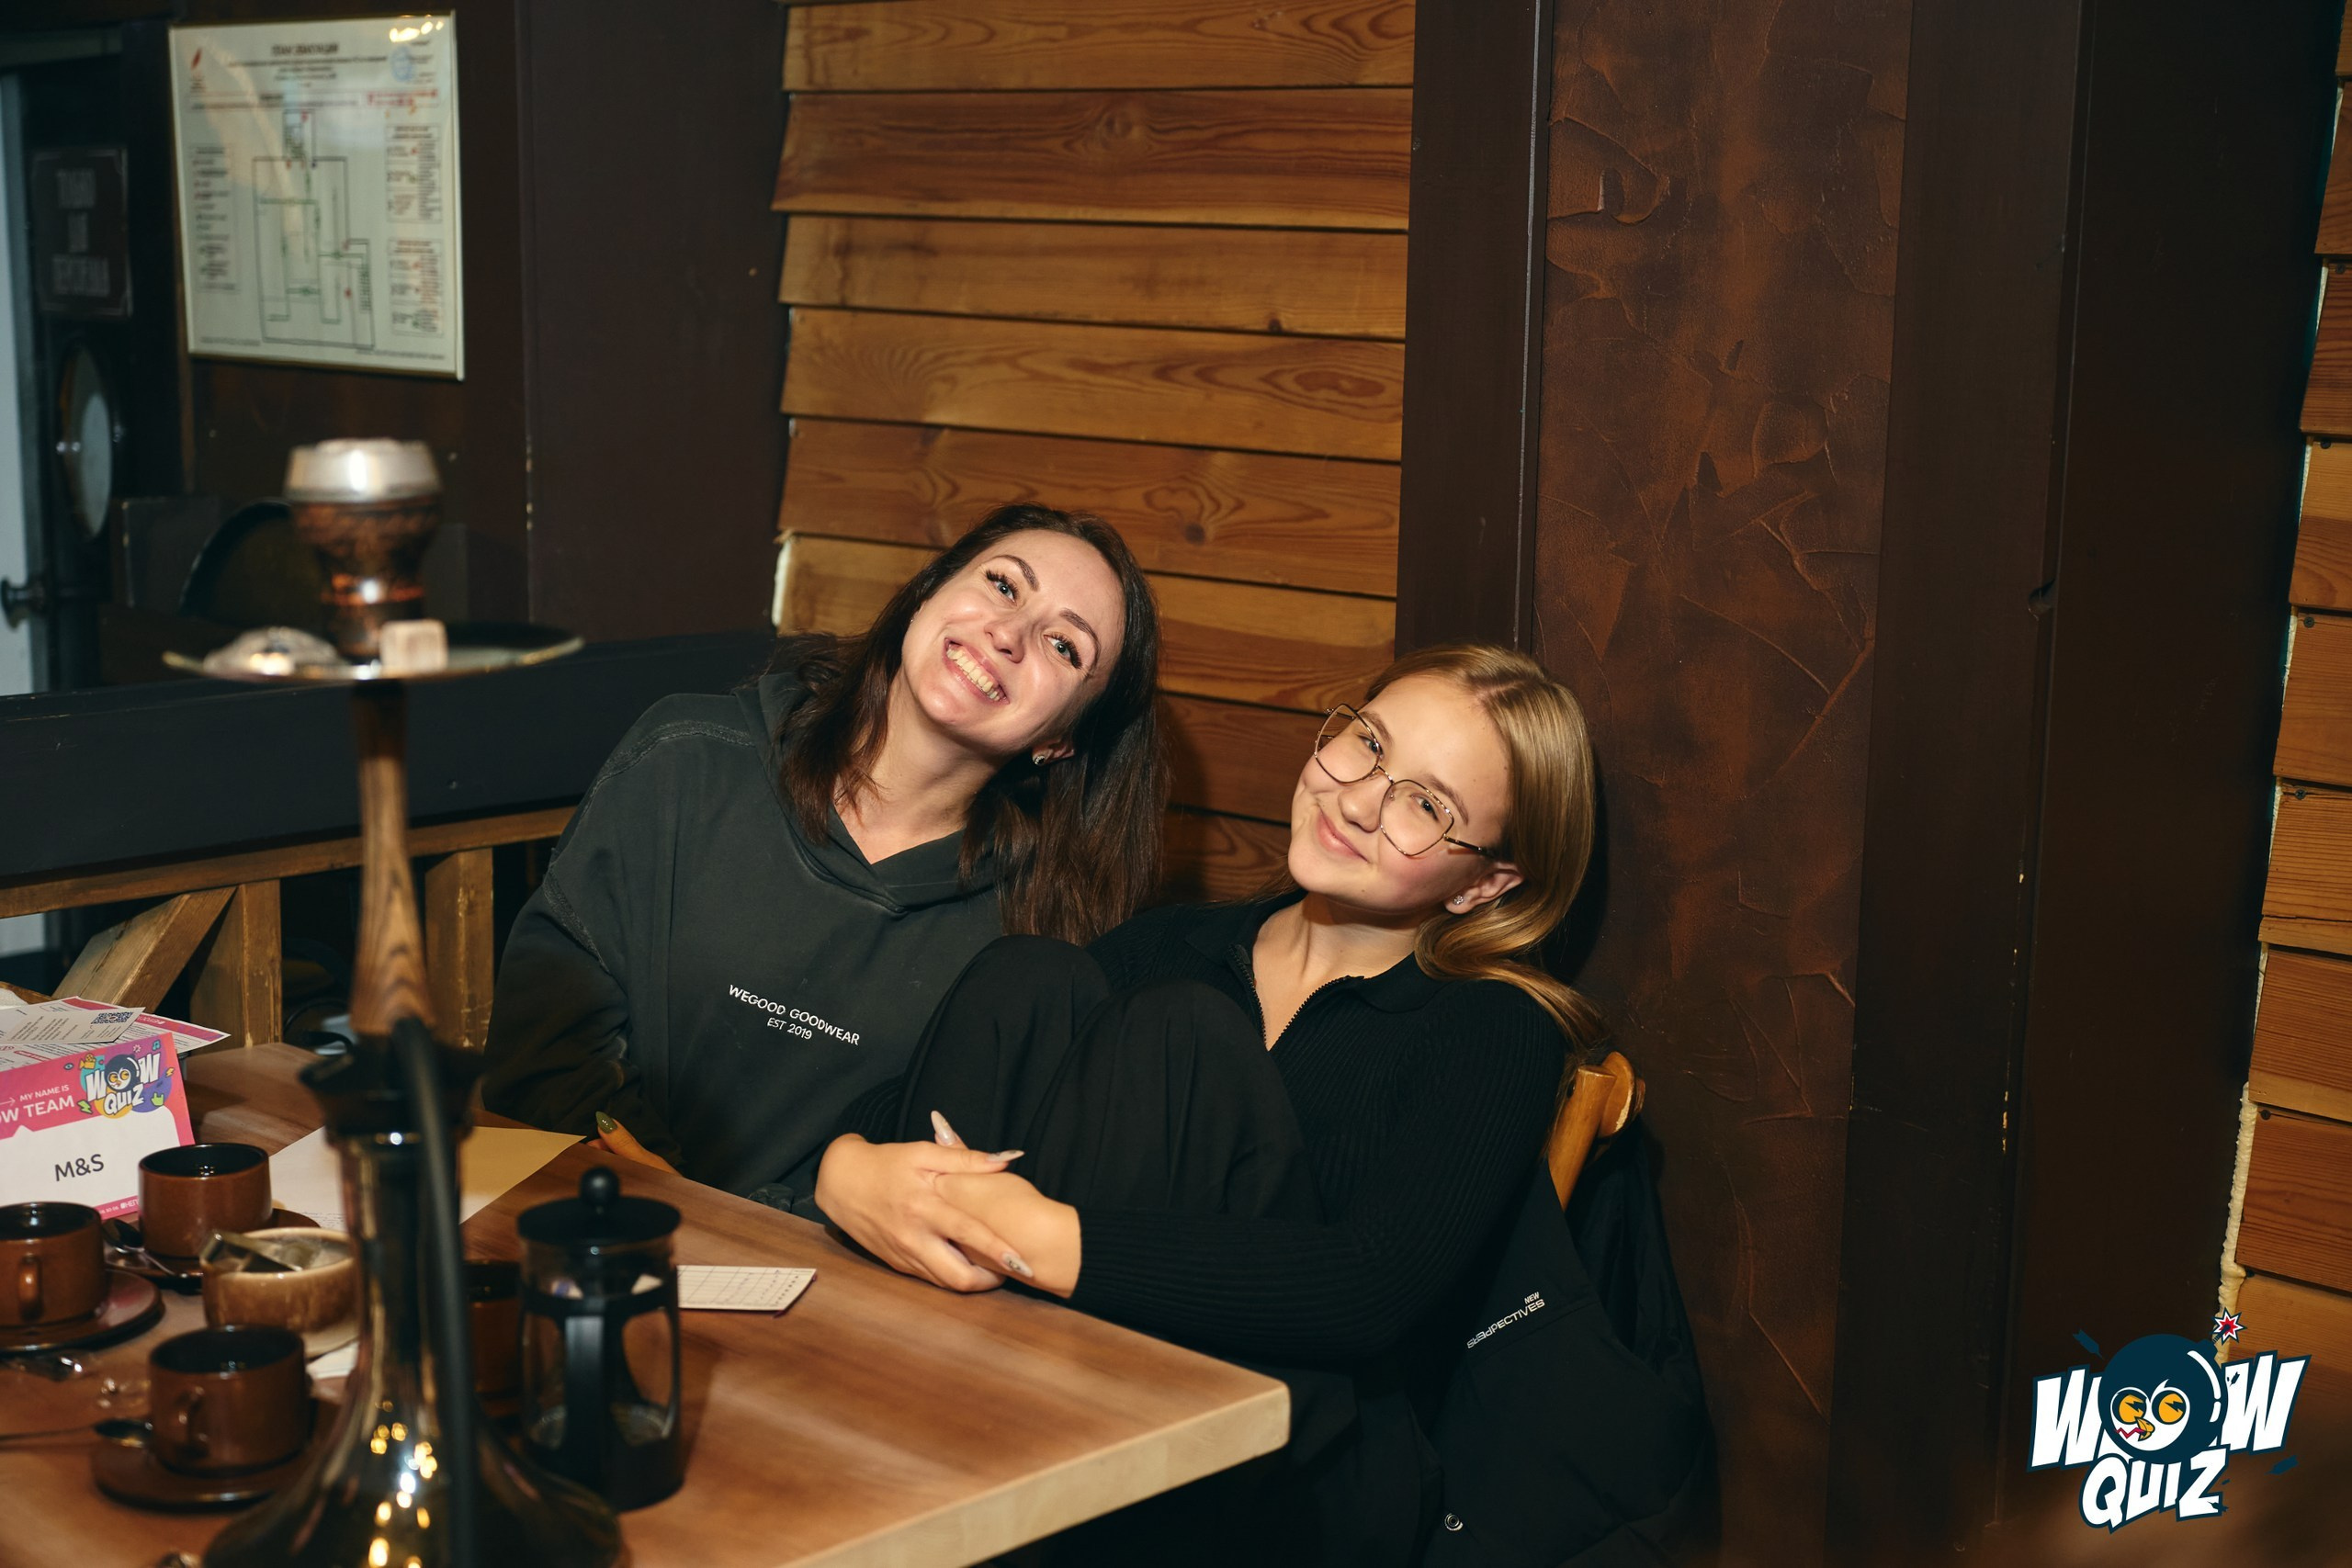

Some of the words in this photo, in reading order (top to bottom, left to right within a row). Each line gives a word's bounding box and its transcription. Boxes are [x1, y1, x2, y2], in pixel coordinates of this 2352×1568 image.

[729, 984, 786, 1015] WEGOOD
[789, 1009, 860, 1045] GOODWEAR
[767, 1017, 786, 1030] EST
[787, 1023, 813, 1040] 2019
[19, 1092, 33, 1101] MY
[35, 1087, 61, 1099] NAME
[62, 1084, 70, 1092] IS
[104, 1083, 144, 1115] QUIZ
[23, 1095, 74, 1118] TEAM
[54, 1154, 104, 1181] M&S
[1524, 1292, 1540, 1304] NEW
